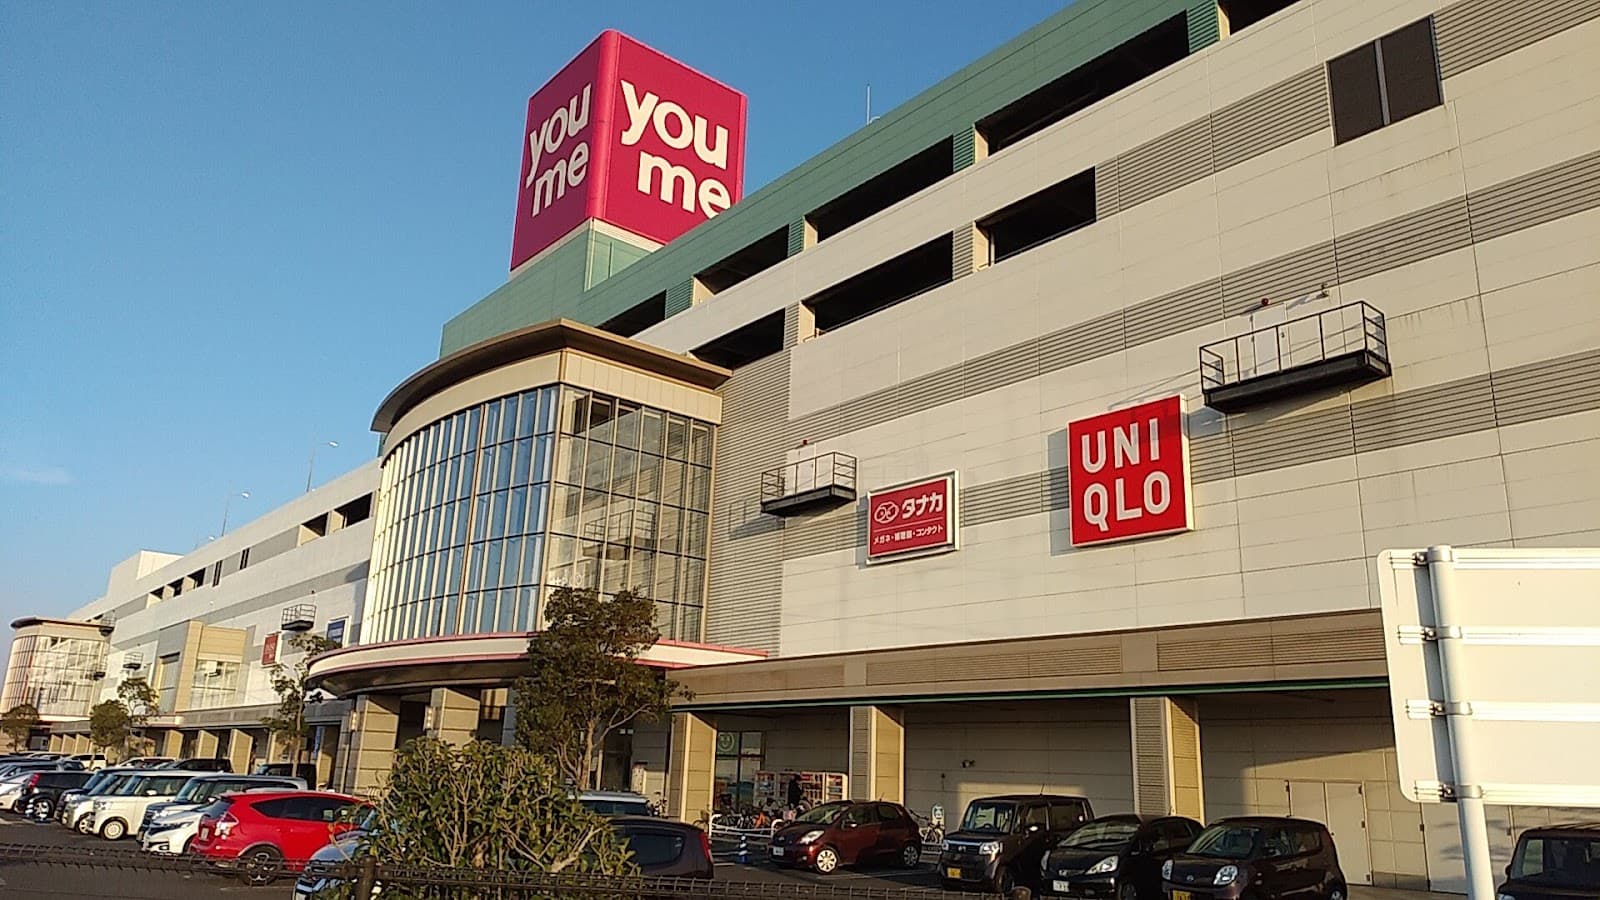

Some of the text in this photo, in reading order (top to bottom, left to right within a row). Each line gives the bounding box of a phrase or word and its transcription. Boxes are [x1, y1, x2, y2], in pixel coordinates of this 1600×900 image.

[526, 83, 591, 189] you
[620, 80, 729, 170] you
[531, 141, 590, 218] me
[637, 151, 731, 218] me
[1081, 417, 1160, 474] UNI
[902, 492, 943, 519] タナカ
[1083, 470, 1171, 532] QLO
